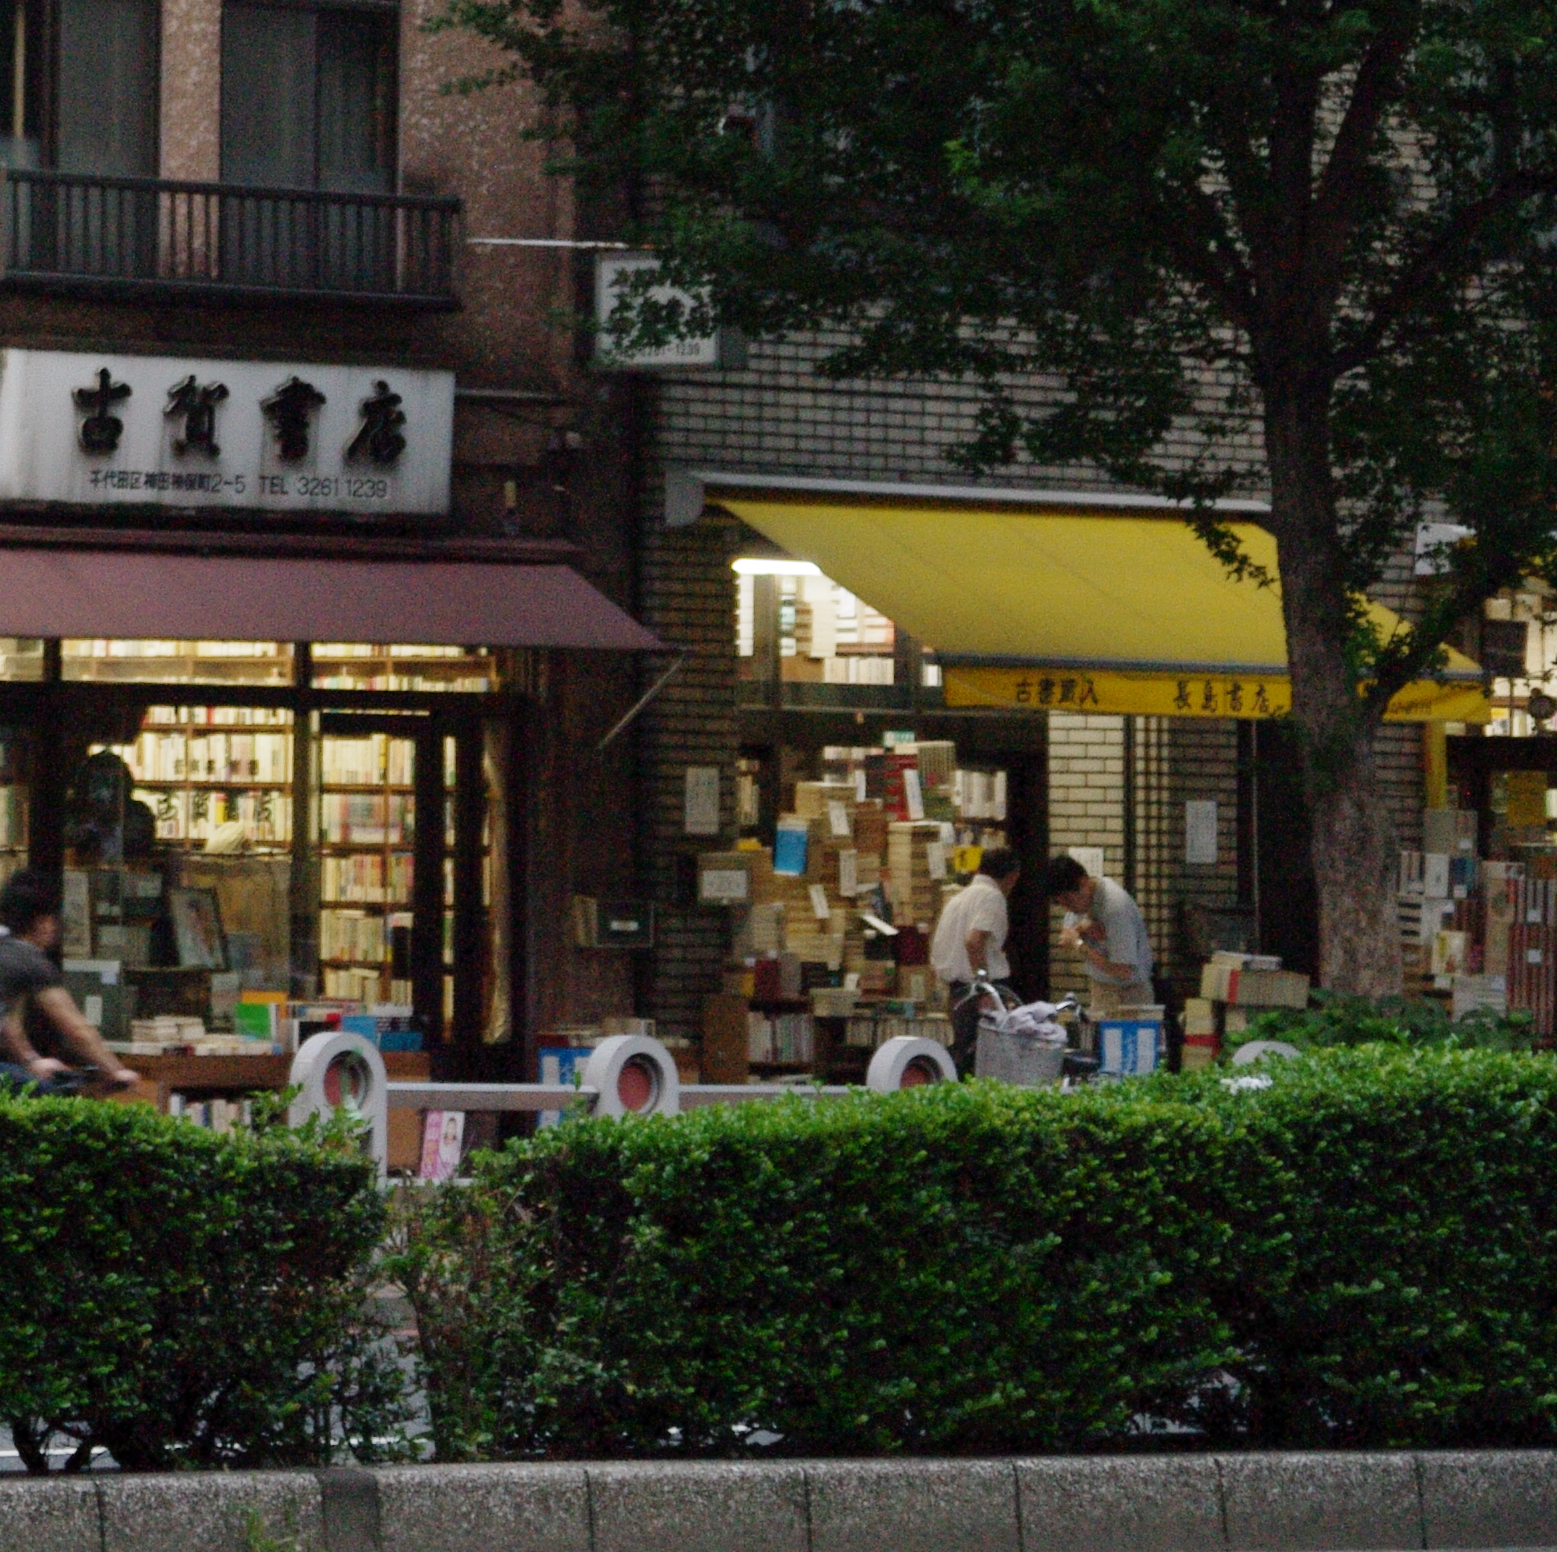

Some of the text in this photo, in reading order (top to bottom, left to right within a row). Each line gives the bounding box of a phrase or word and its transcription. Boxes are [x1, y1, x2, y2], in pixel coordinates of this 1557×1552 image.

[72, 367, 407, 464] 古賀書店
[258, 476, 289, 495] TEL
